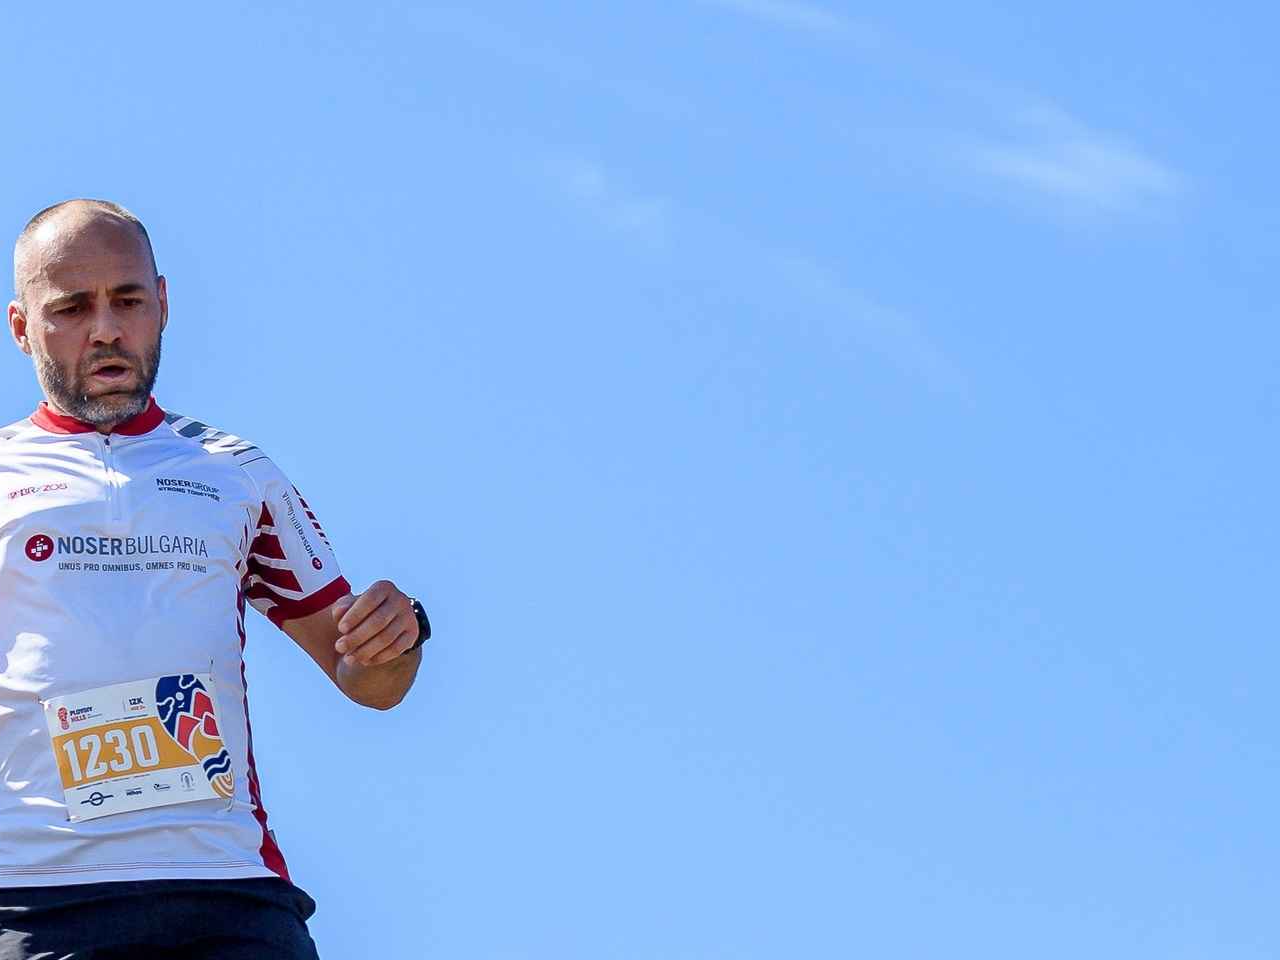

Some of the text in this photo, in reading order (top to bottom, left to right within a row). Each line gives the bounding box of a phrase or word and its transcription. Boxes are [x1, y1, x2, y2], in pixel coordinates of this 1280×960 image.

[158, 486, 186, 494] STRONG
[57, 535, 208, 558] NOSERBULGARIA
[58, 561, 207, 574] UNUS PRO OMNIBUS, OMNES PRO UNO
[128, 696, 144, 706] 12K
[62, 724, 160, 782] 1230
